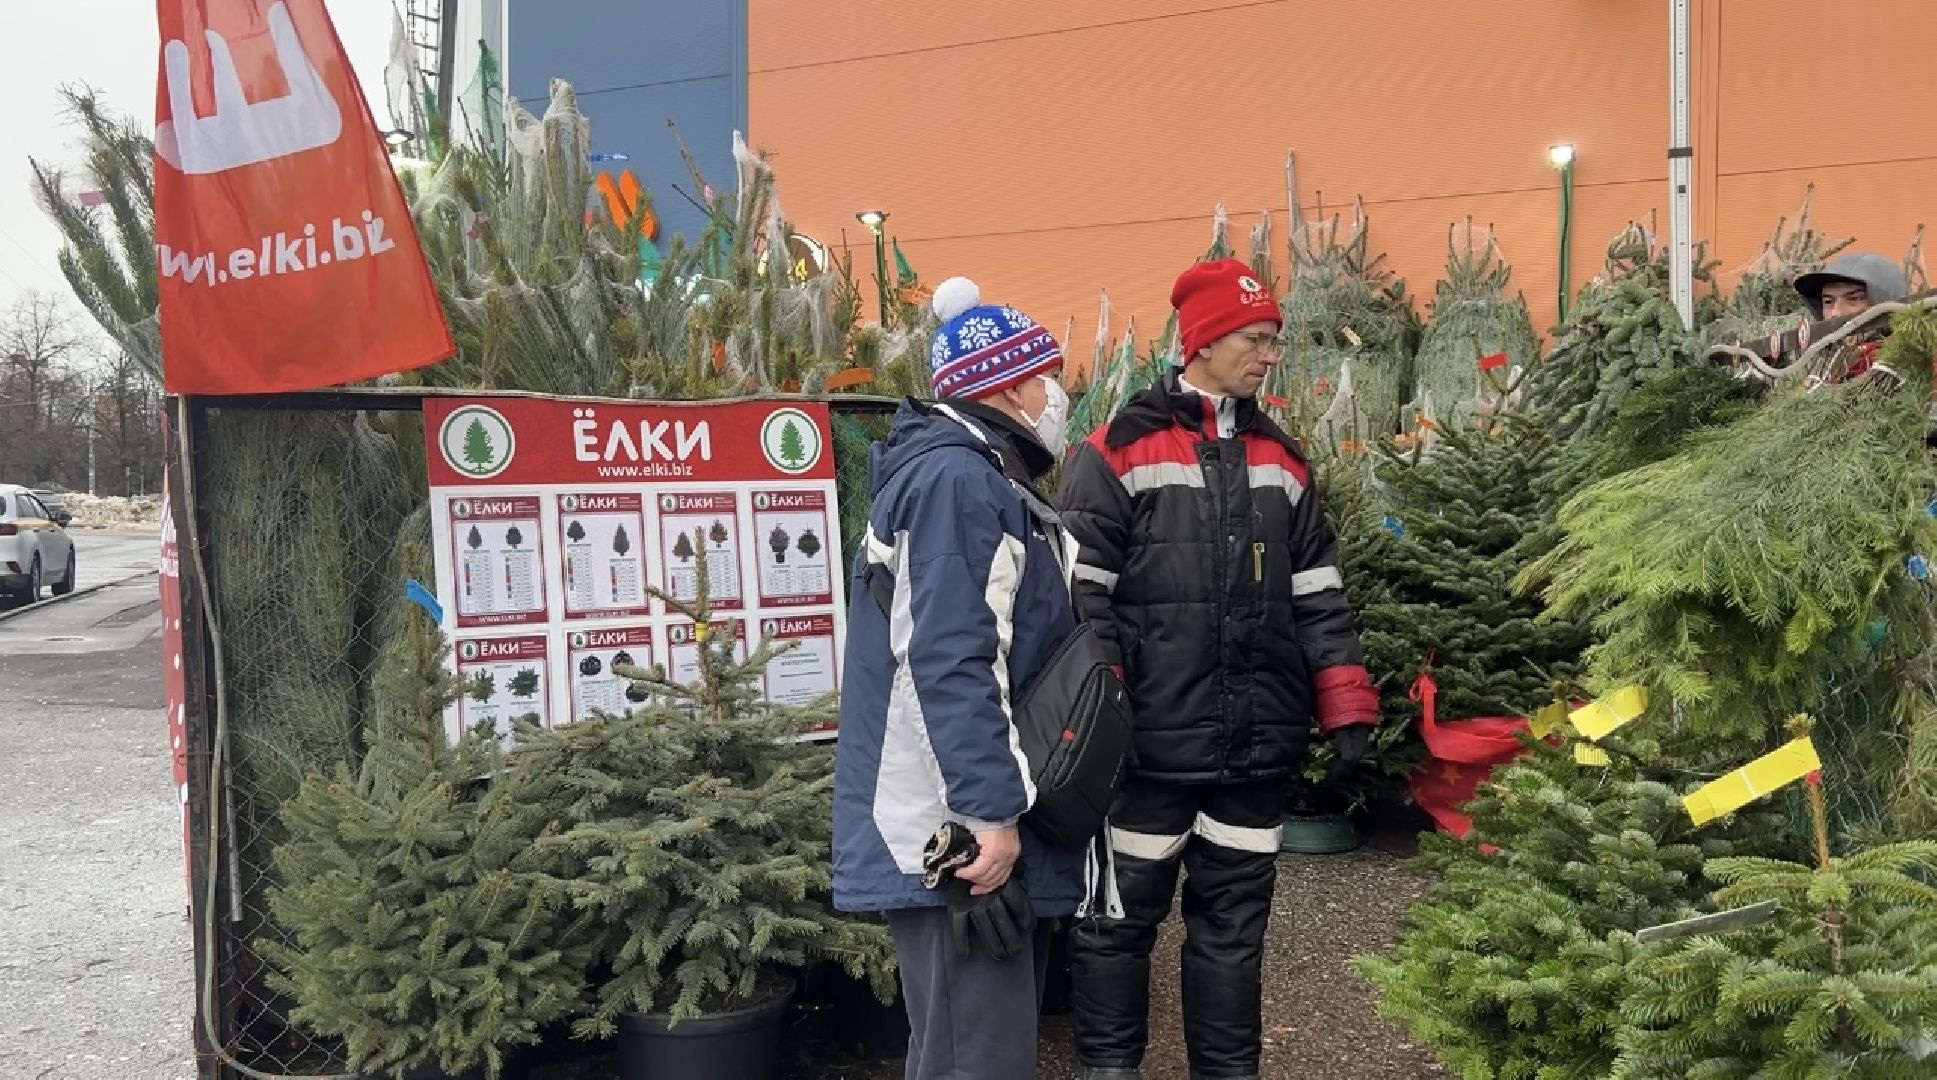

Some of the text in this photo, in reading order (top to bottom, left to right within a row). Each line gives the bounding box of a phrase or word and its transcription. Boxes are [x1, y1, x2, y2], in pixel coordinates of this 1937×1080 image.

[573, 408, 712, 461] ЁЛКИ
[597, 463, 693, 476] www.elki.biz
[474, 499, 513, 515] ЁЛКИ
[580, 493, 617, 509] ЁЛКИ
[679, 493, 713, 509] ЁЛКИ
[771, 493, 803, 506] ЁЛКИ
[779, 618, 812, 633] ЁЛКИ
[590, 630, 627, 645] ЁЛКИ
[481, 638, 519, 657] ЁЛКИ
